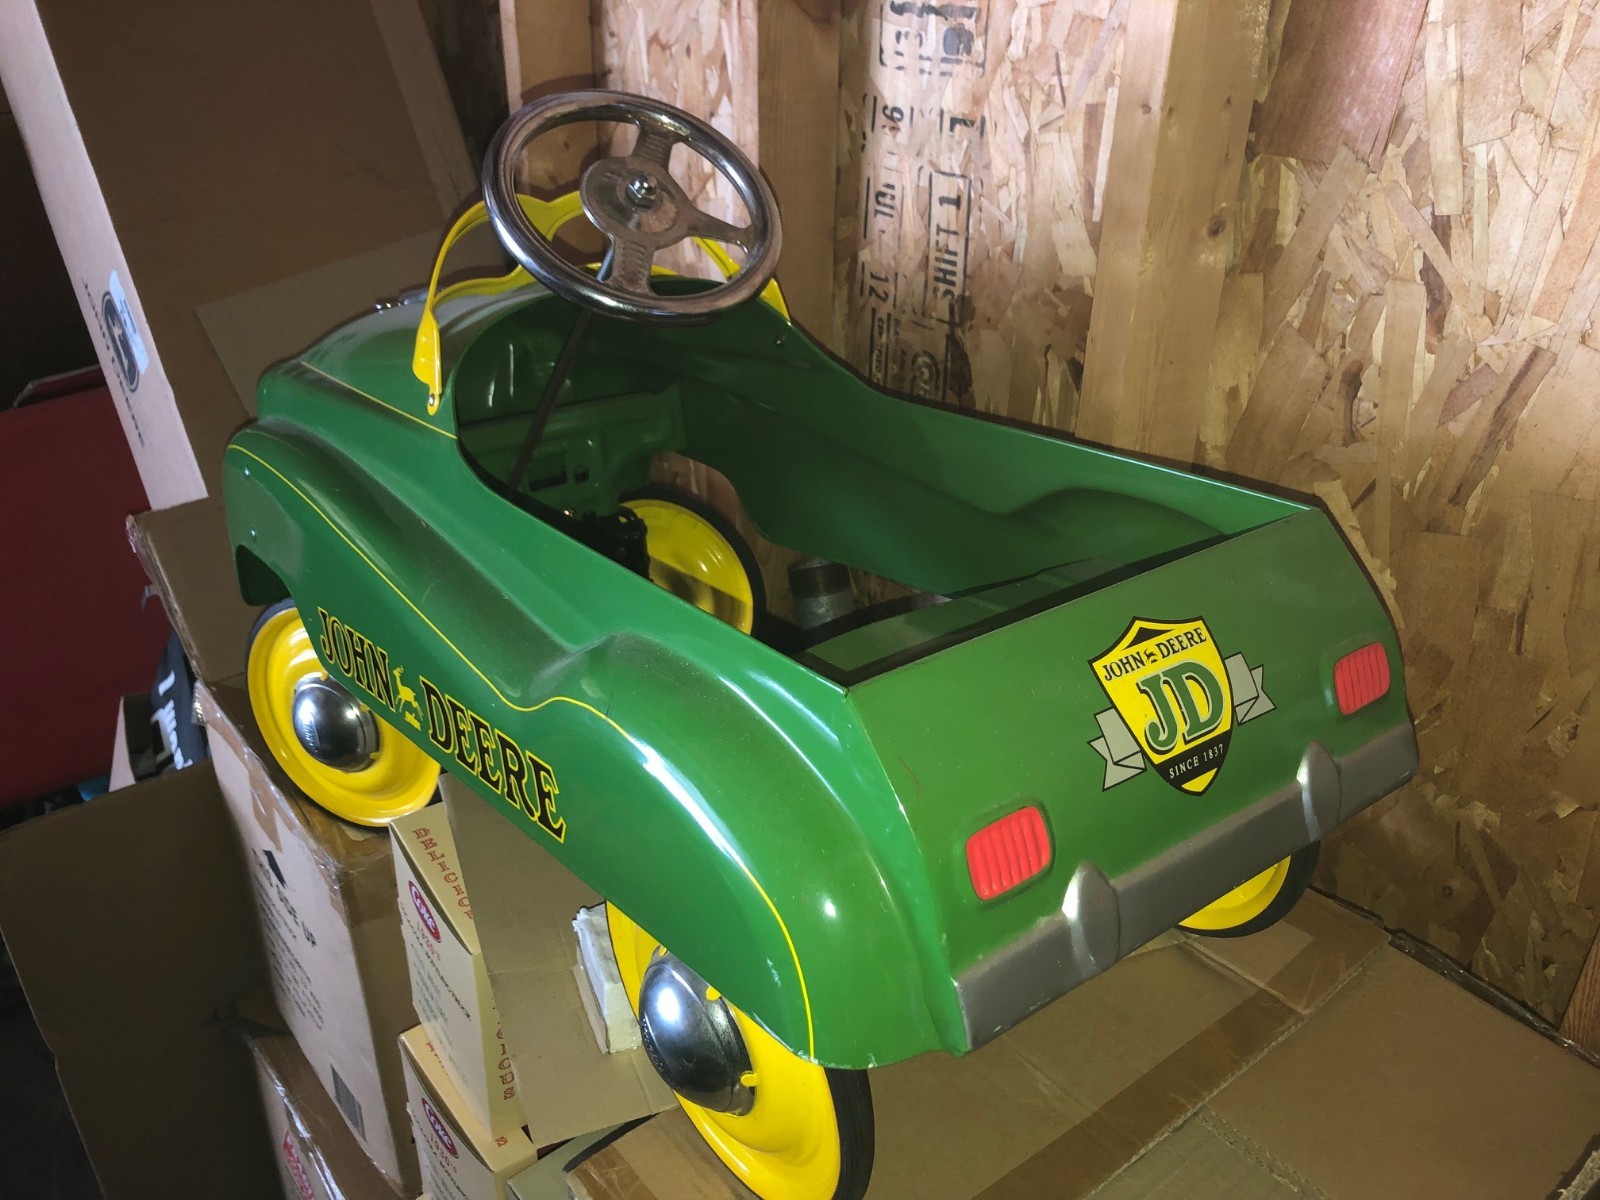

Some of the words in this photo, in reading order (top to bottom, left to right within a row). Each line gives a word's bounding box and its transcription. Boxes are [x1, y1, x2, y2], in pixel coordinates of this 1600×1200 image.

[932, 223, 960, 301] SHIFT
[1102, 651, 1146, 681] JOHN
[1155, 627, 1207, 659] DEERE
[317, 606, 397, 714] JOHN
[419, 674, 567, 844] DEERE
[1136, 659, 1226, 756] JD
[1169, 755, 1200, 779] SINCE
[1203, 744, 1224, 762] 1837
